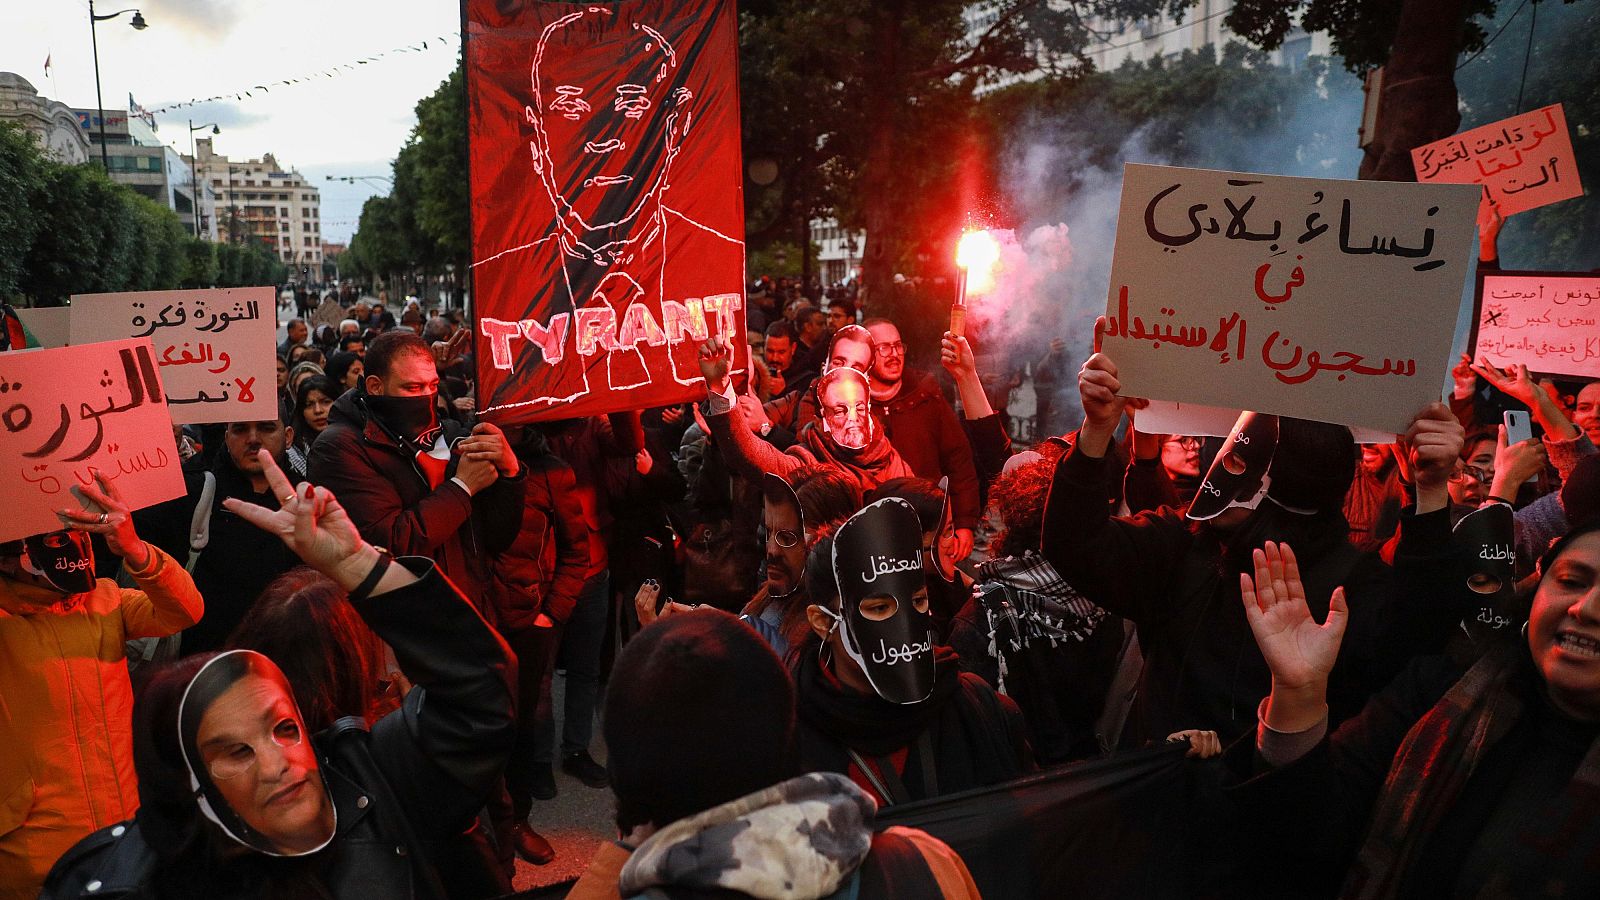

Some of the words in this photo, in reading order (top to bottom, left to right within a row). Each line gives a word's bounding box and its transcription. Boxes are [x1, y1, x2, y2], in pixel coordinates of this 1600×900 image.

[1254, 255, 1306, 310] في
[131, 301, 187, 338] فكرة
[195, 300, 259, 333] الثورة
[480, 293, 742, 371] TYRANT
[1103, 285, 1247, 364] الإستبداد
[1509, 308, 1551, 329] كبير
[1557, 316, 1596, 328] سجن
[159, 342, 231, 374] والفك
[1262, 330, 1416, 385] سجون
[0, 345, 163, 462] الثورة
[234, 376, 256, 403] لا
[861, 549, 924, 584] المعتقل
[1479, 543, 1515, 565] واطنة
[872, 630, 933, 666] المجهول
